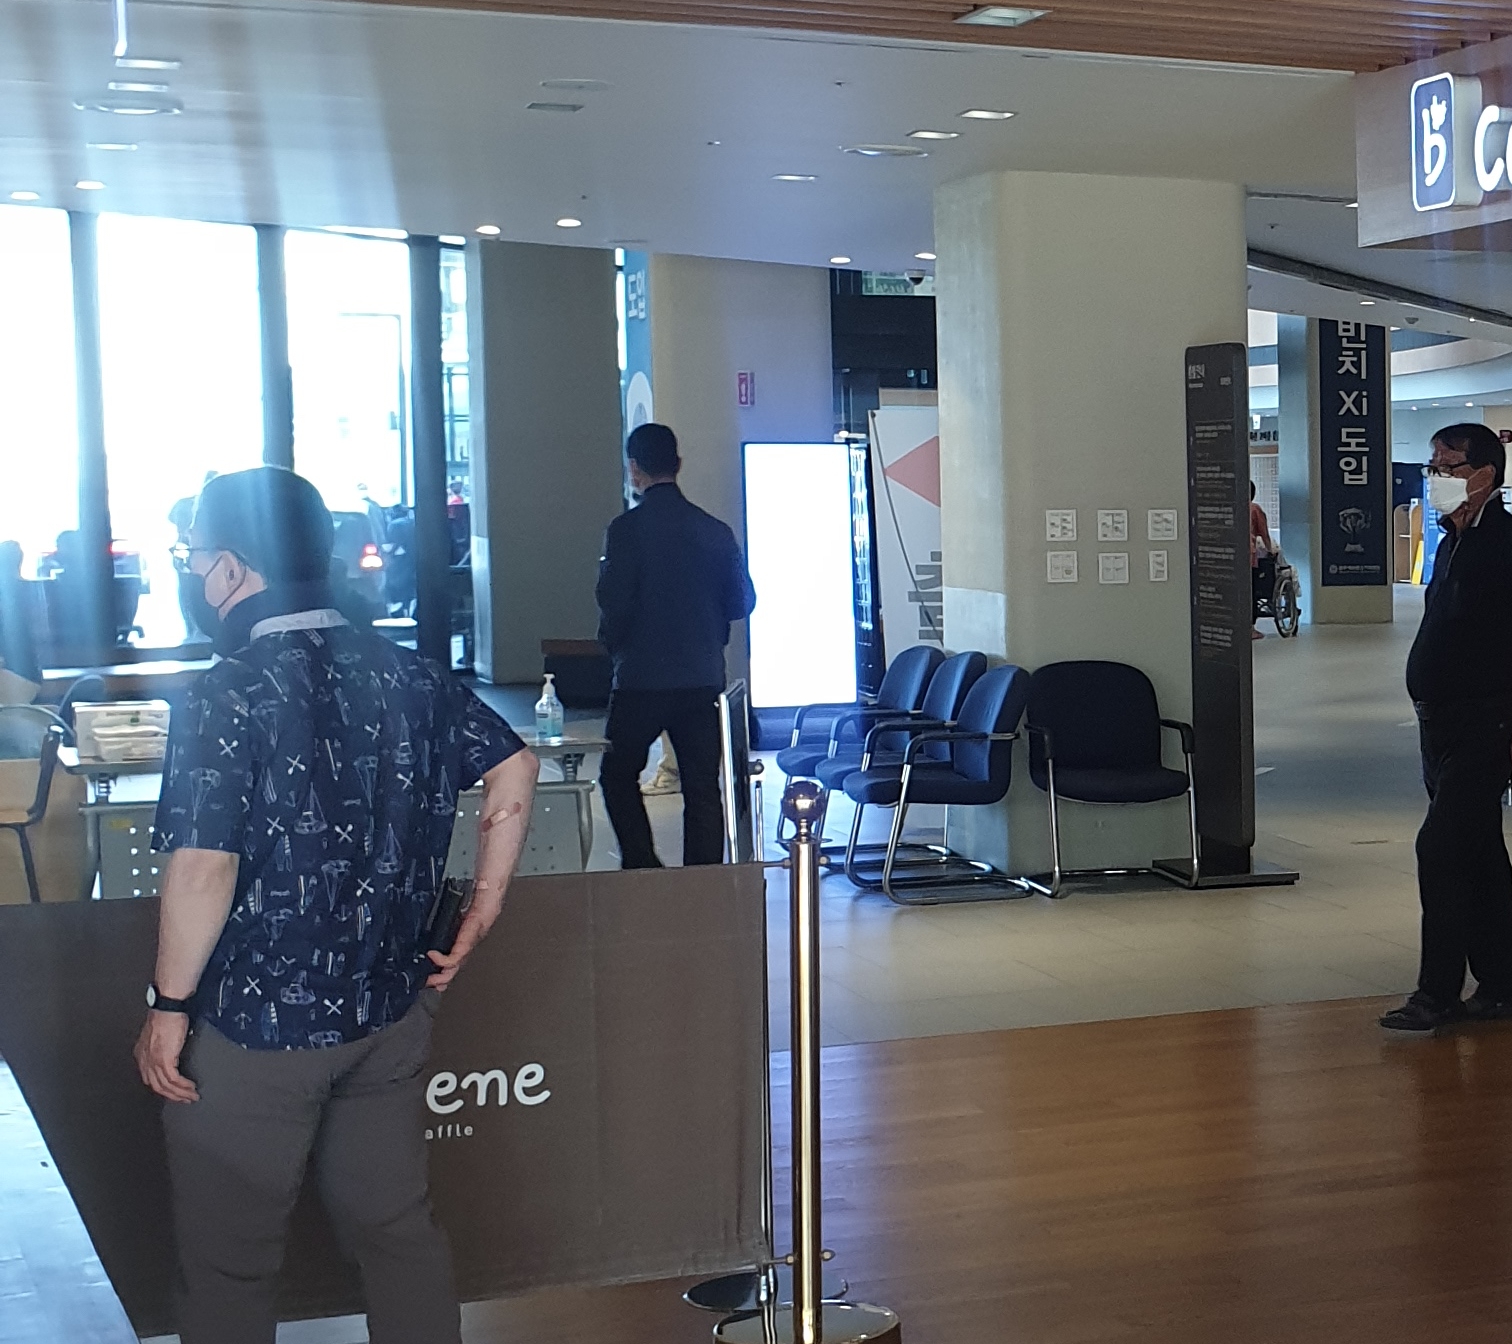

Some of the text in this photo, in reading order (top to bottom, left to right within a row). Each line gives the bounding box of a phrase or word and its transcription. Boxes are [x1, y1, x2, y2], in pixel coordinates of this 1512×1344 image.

[1338, 390, 1368, 416] Xi
[1337, 427, 1370, 485] 도입
[426, 1063, 551, 1114] ene
[425, 1124, 473, 1140] affle
